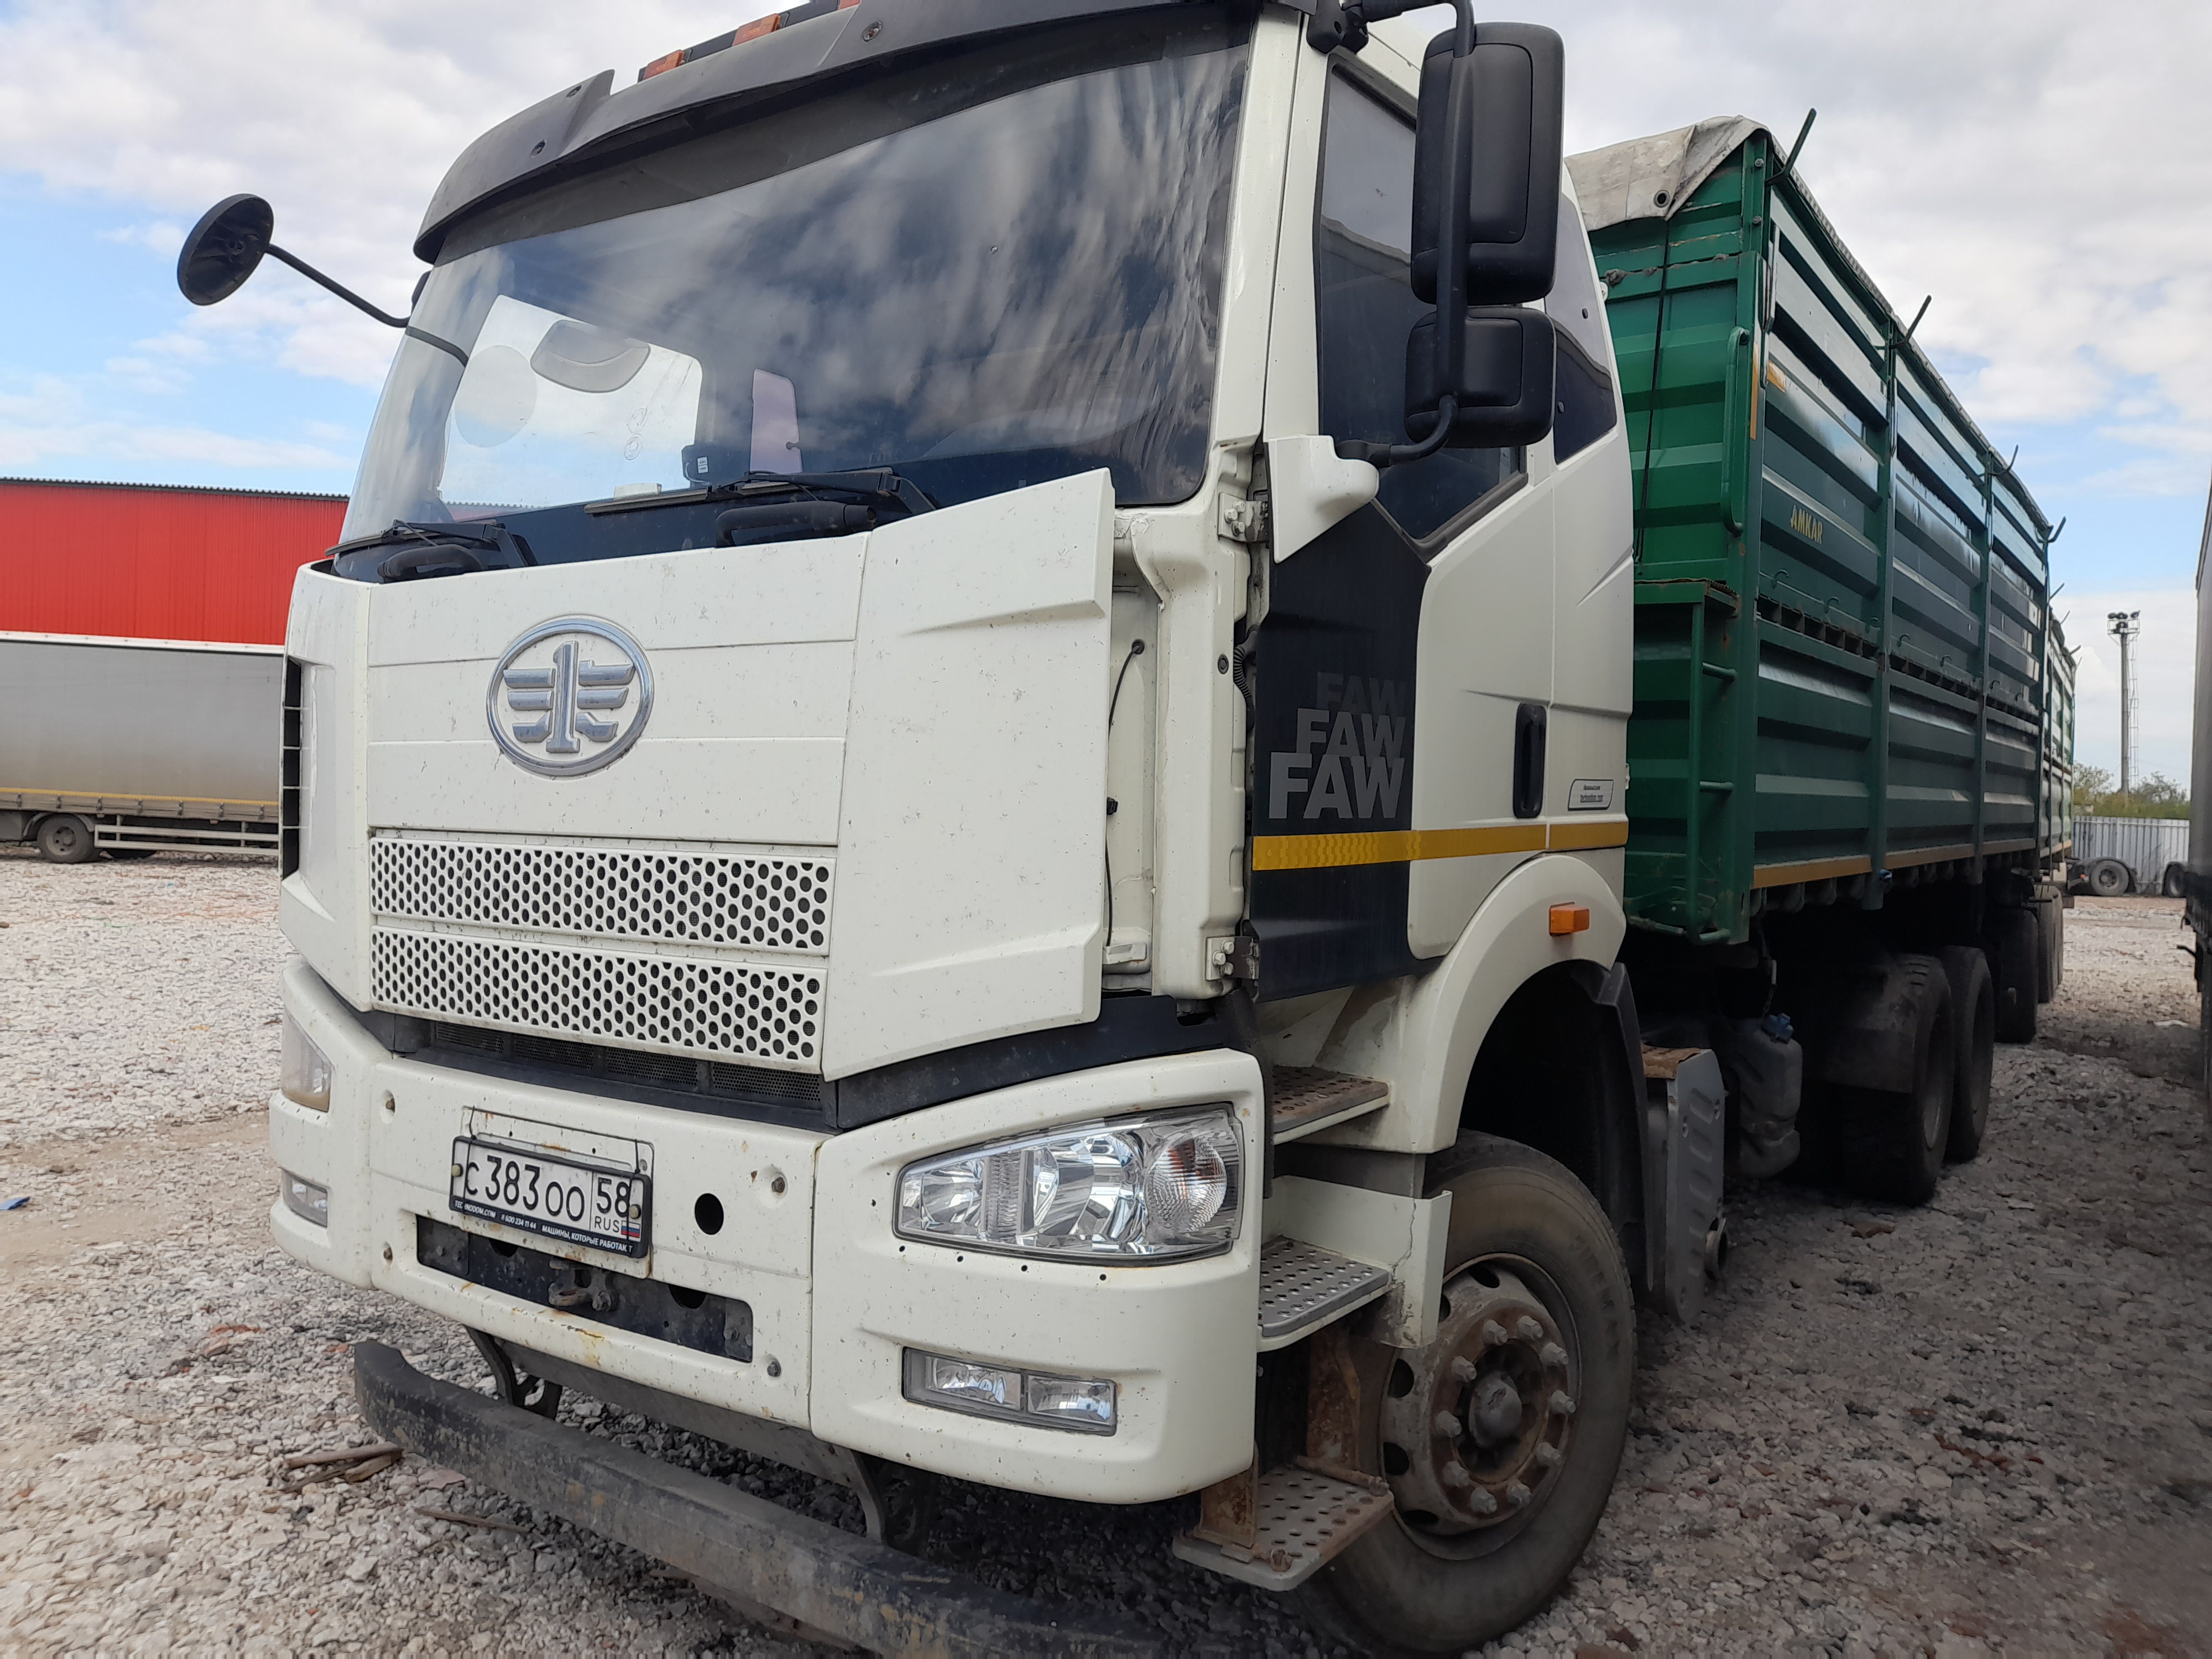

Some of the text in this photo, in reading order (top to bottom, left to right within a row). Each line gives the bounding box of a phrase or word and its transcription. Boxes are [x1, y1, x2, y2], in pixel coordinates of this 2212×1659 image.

[1790, 504, 1823, 545] AMKAR
[1316, 671, 1407, 724] FAW
[1296, 707, 1406, 768] FAW
[1269, 752, 1405, 819] FAW
[596, 1177, 630, 1218] 58
[571, 1233, 599, 1245] КОТОРЫЕ
[594, 1216, 619, 1233] RUS
